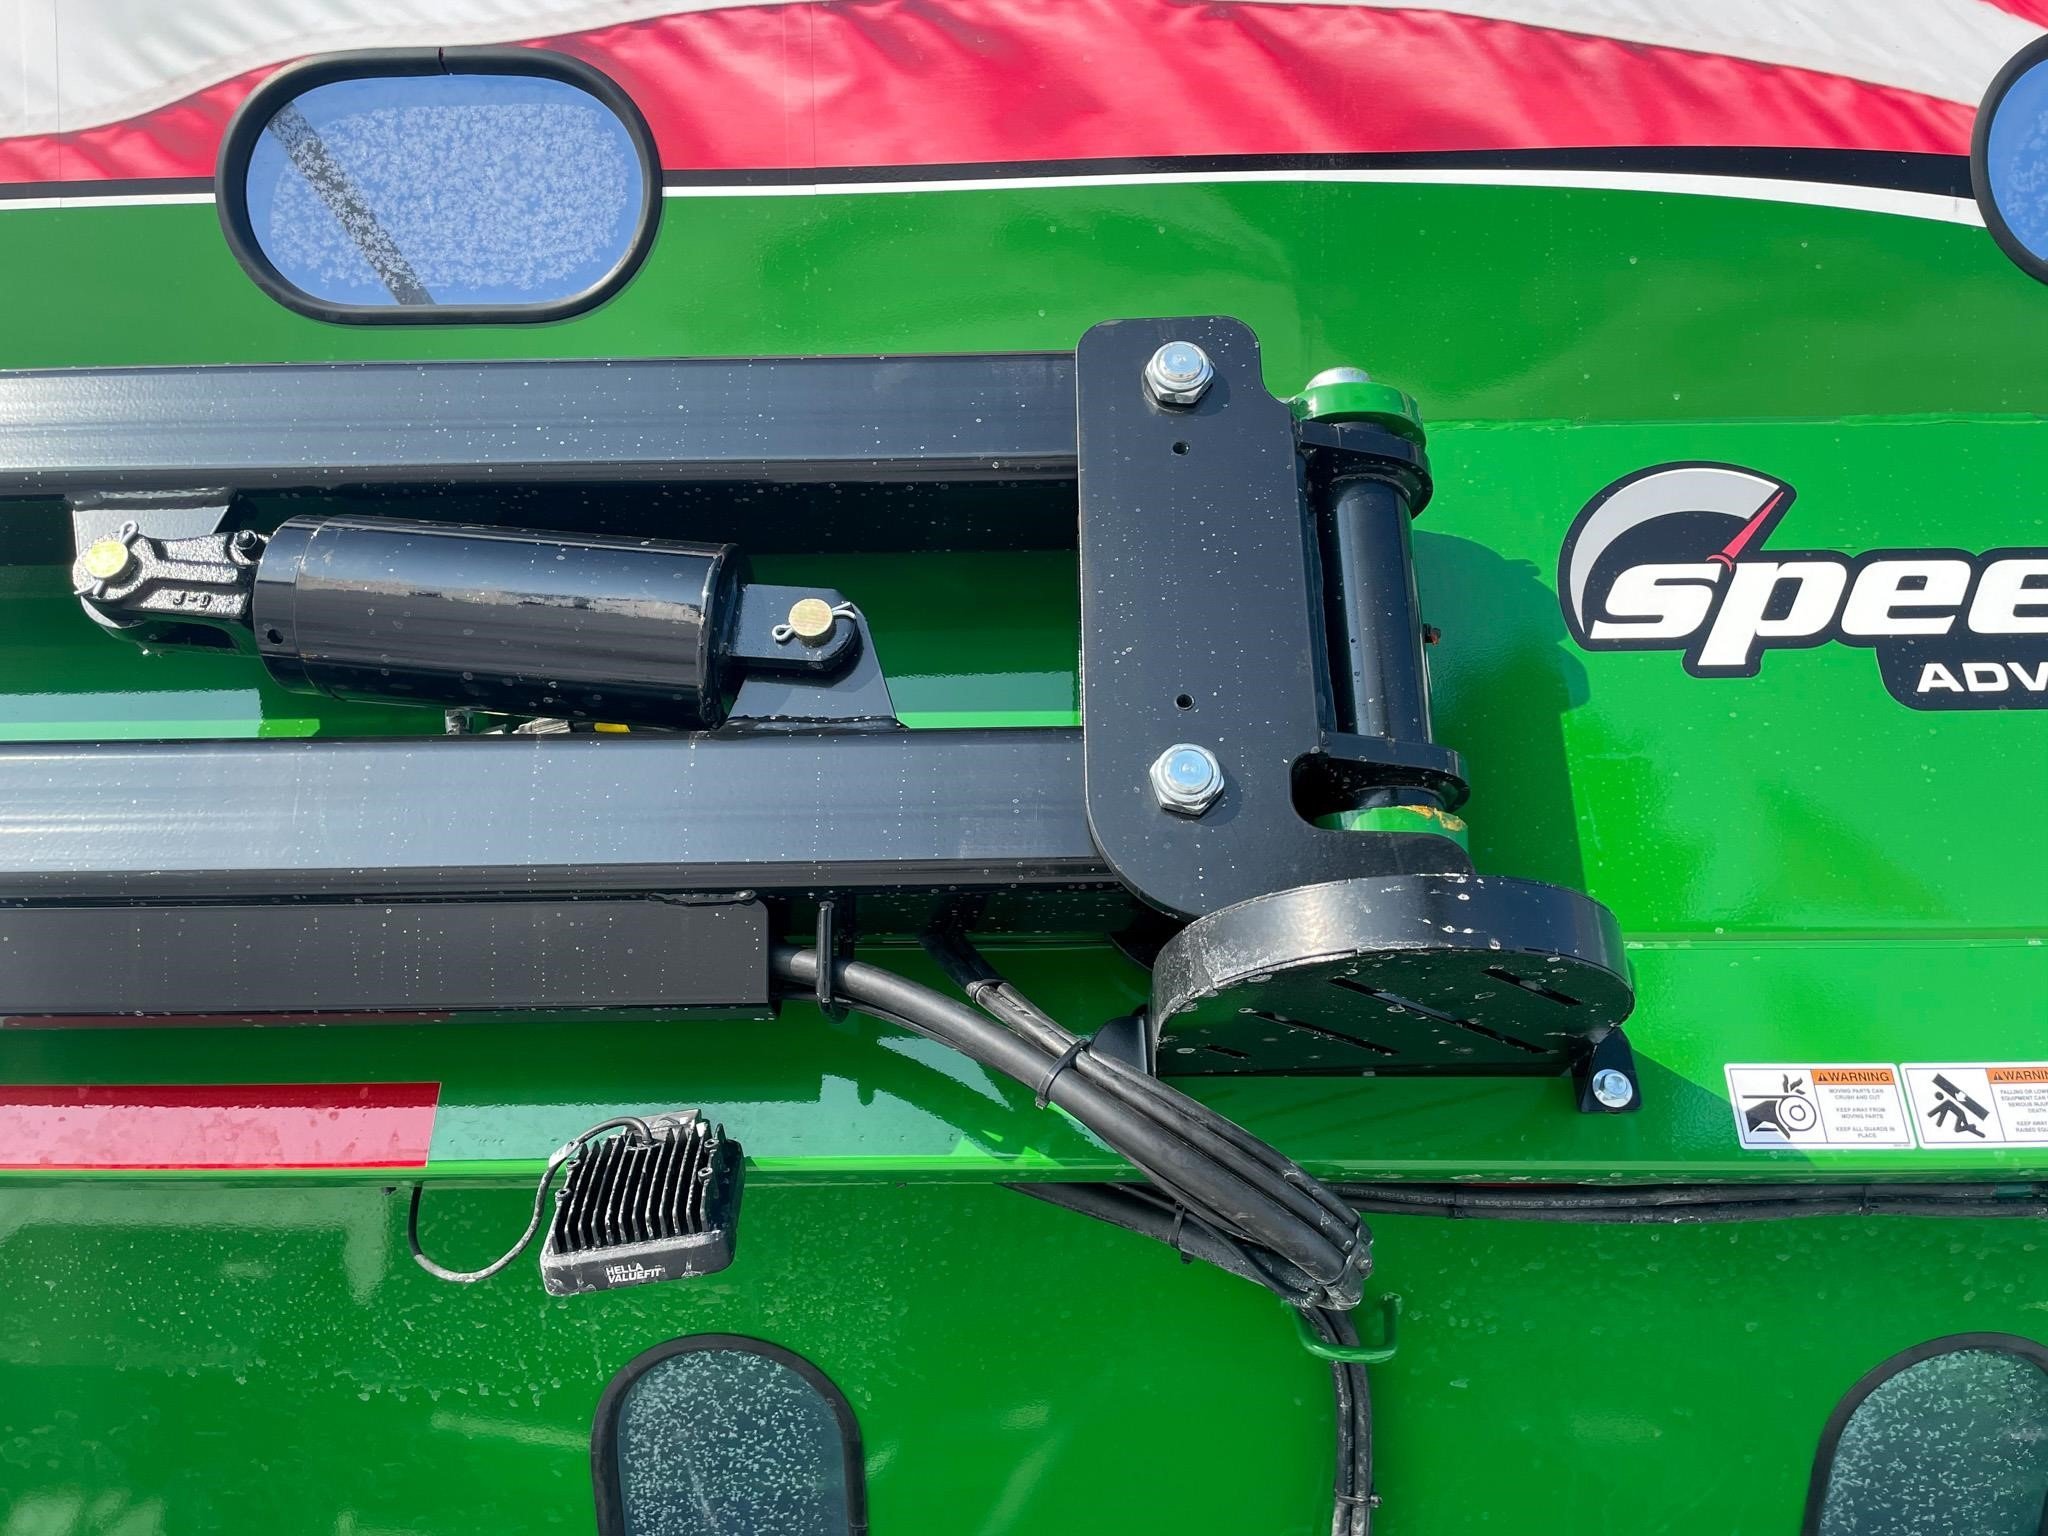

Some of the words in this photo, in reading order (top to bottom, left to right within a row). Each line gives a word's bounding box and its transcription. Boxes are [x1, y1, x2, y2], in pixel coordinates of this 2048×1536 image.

[1916, 662, 2048, 693] ADV
[1827, 1071, 1890, 1082] WARNING
[605, 1262, 644, 1276] HELLA
[608, 1268, 662, 1284] VALUEFIT
